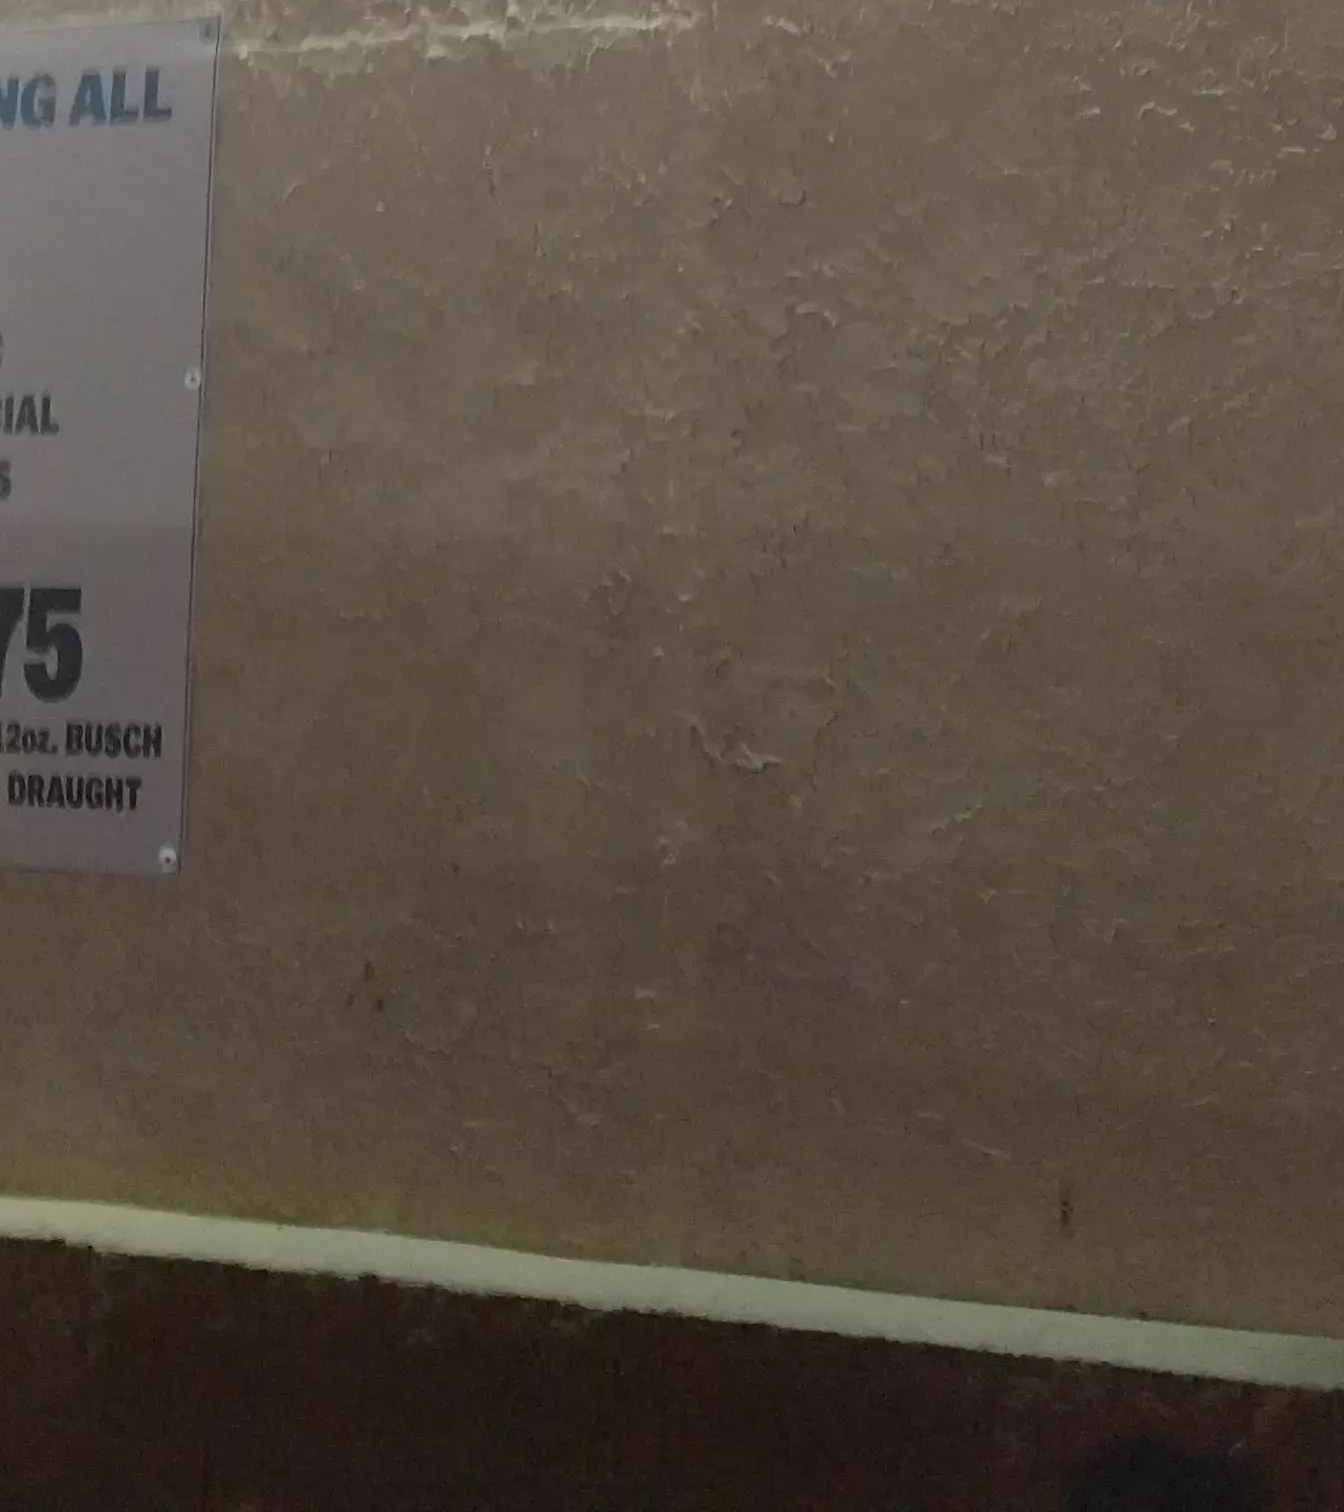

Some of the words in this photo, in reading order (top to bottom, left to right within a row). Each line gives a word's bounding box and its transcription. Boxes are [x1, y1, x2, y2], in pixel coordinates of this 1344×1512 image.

[67, 64, 175, 128] ALL
[64, 718, 163, 760] BUSCH
[6, 768, 144, 814] DRAUGHT
